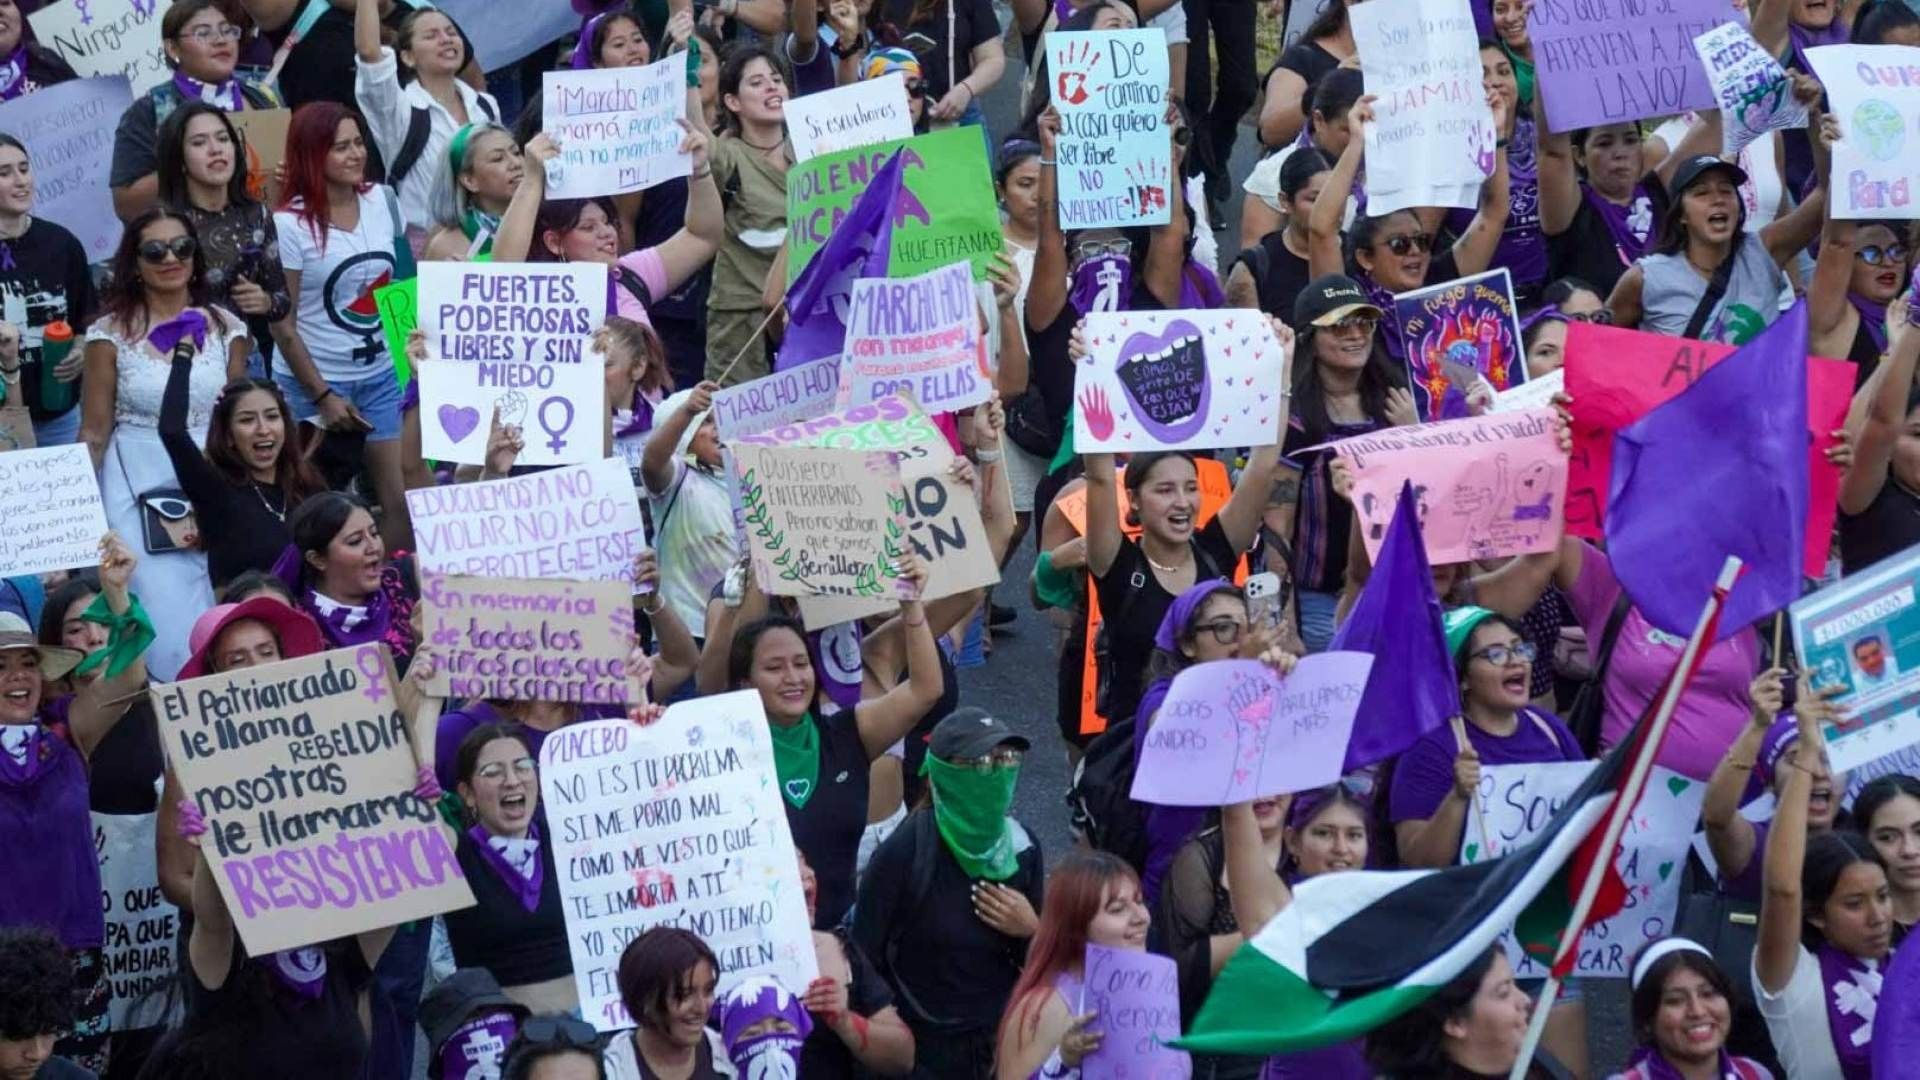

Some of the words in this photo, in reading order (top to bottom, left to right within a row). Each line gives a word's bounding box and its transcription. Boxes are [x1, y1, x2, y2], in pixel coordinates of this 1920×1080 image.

[53, 6, 150, 58] Ninguna
[1541, 29, 1640, 73] ATREVEN
[1650, 27, 1668, 62] A
[1109, 39, 1149, 79] De
[1105, 81, 1160, 110] camino
[1637, 65, 1692, 111] VOZ
[1076, 112, 1109, 139] casa
[1112, 110, 1157, 142] quiero
[1060, 142, 1080, 166] ser
[1082, 142, 1117, 166] libre
[1078, 169, 1104, 193] NO
[850, 278, 938, 337] MARCHO
[441, 334, 514, 361] LIBRES
[522, 336, 539, 363] Y
[545, 338, 582, 364] SIN
[478, 362, 554, 389] MIEDO
[715, 370, 799, 426] MARCHO
[803, 360, 844, 397] HOY
[922, 364, 977, 404] ELLAS
[812, 414, 938, 450] OCES
[537, 477, 551, 501] A
[556, 468, 593, 499] NO
[414, 513, 511, 556] VIOLAR
[512, 499, 560, 546] NO
[564, 508, 581, 532] A
[469, 587, 597, 616] memoria
[431, 618, 461, 646] de
[164, 687, 189, 721] El
[198, 659, 357, 725] Patriarcado
[1166, 700, 1213, 719] ODAS
[180, 729, 215, 760] le
[215, 711, 316, 751] llama
[549, 726, 628, 766] PLACEBO
[195, 762, 348, 817] nosotras
[553, 773, 587, 805] NO
[598, 764, 628, 797] ES
[630, 758, 660, 791] TU
[663, 746, 744, 784] PROBLEMA
[211, 818, 252, 858] le
[259, 790, 437, 848] llamamos
[563, 814, 591, 843] SI
[594, 807, 631, 839] ME
[633, 797, 682, 829] PORTO
[691, 791, 732, 824] MAL
[222, 825, 465, 920] RESISTENCIA
[570, 852, 614, 883] COMO
[622, 843, 655, 871] ME
[656, 834, 718, 865] VISTO
[124, 886, 161, 913] QUE
[570, 895, 598, 920] TE
[606, 881, 678, 916] IMPORTA
[687, 876, 700, 900] A
[136, 915, 174, 943] QUE
[580, 930, 605, 957] YO
[689, 910, 714, 938] NO
[718, 899, 774, 933] TENGO
[102, 946, 171, 976] AMBIAR
[115, 974, 166, 1000] UNDO
